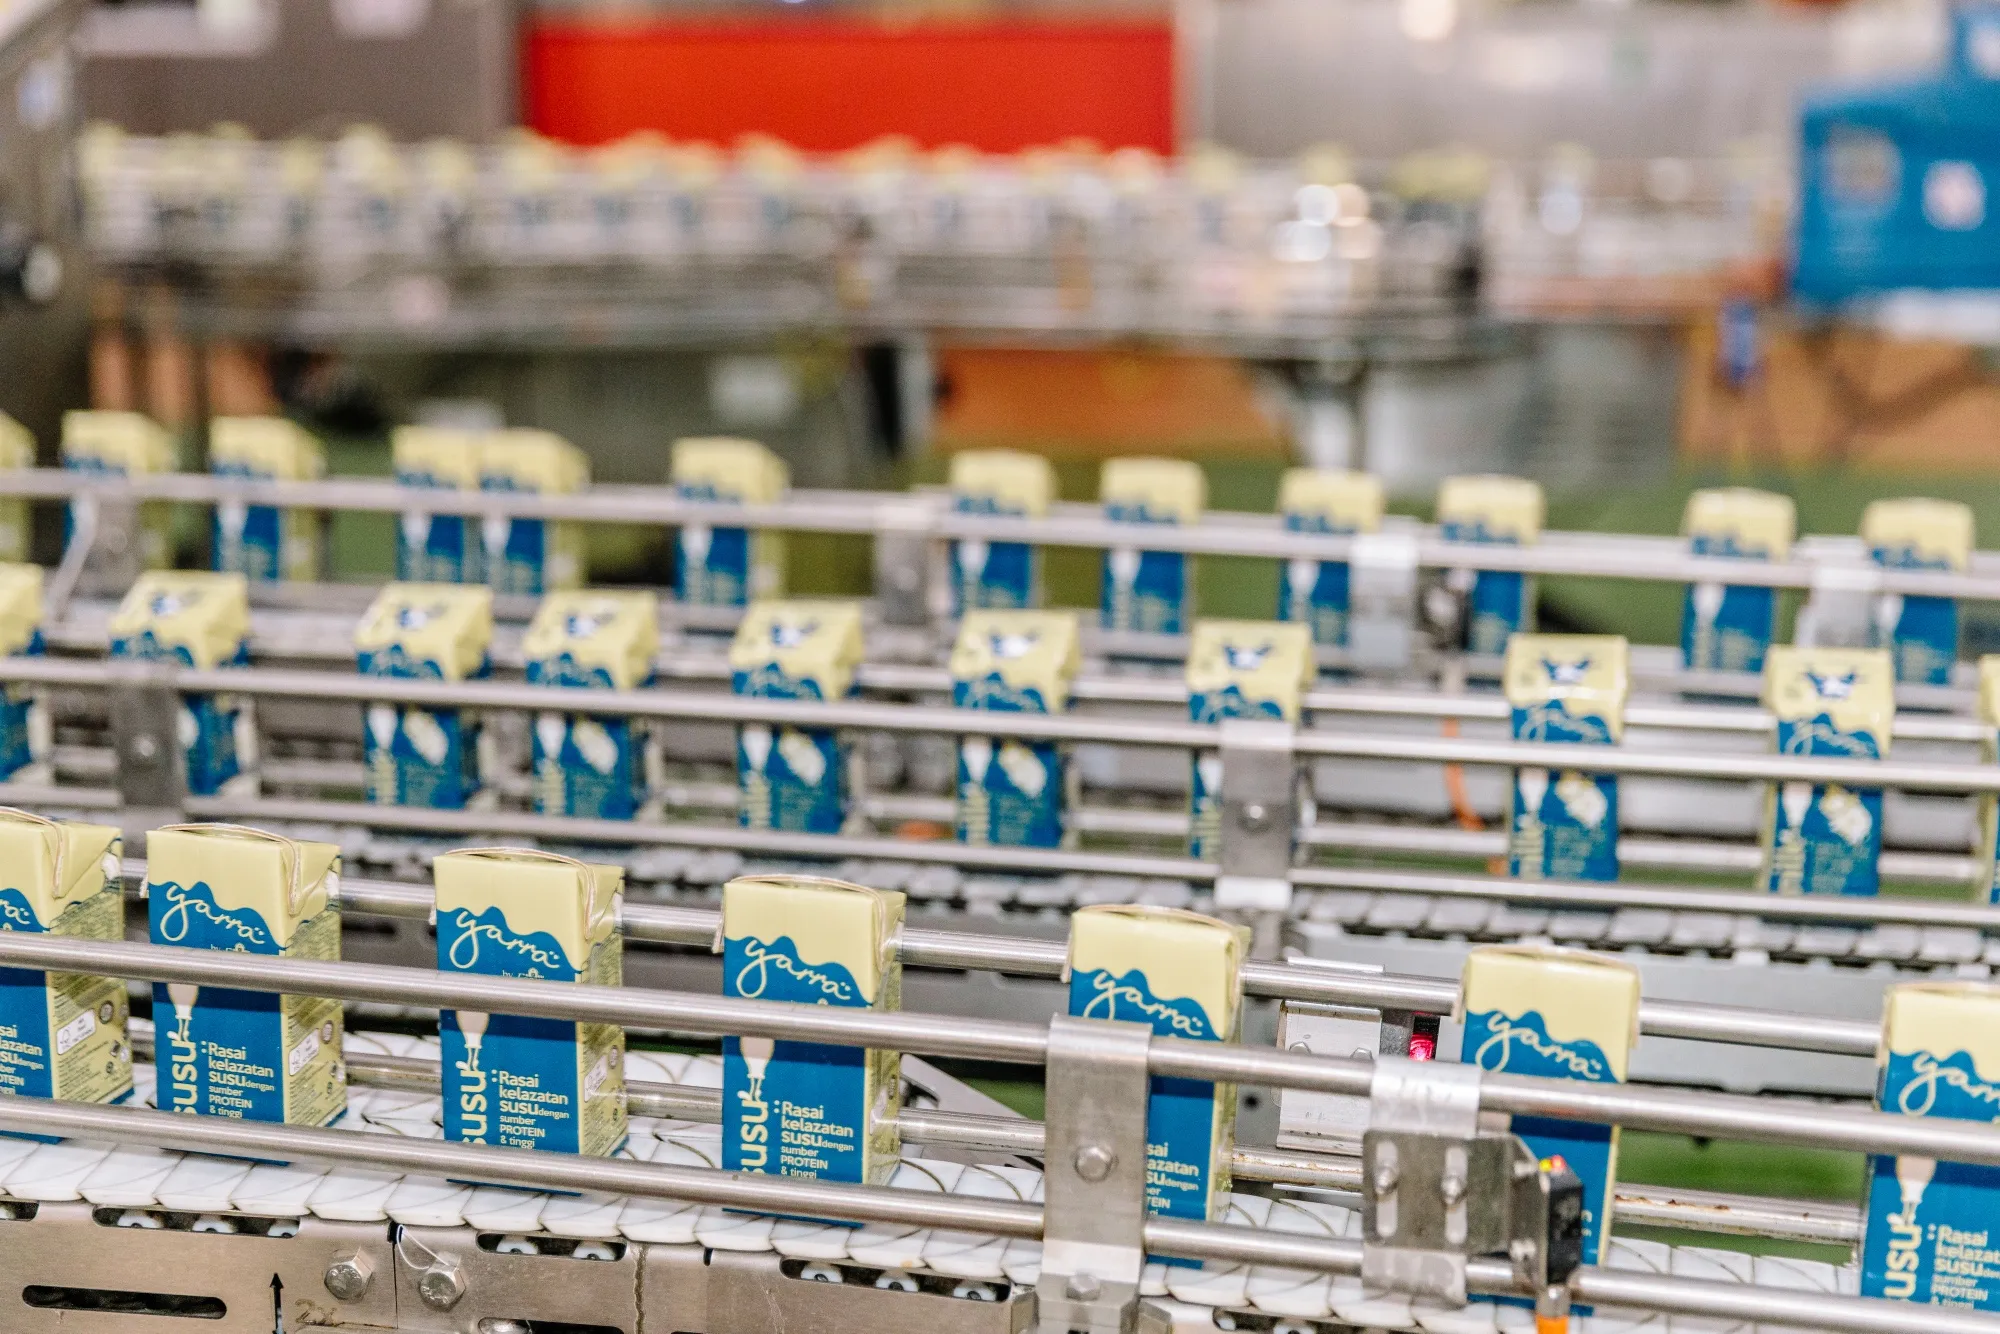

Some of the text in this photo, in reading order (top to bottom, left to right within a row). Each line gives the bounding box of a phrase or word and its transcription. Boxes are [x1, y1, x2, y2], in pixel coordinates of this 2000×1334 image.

[0, 1024, 17, 1039] sai
[0, 1036, 43, 1057] lazatan
[208, 1041, 247, 1060] Rasai
[208, 1056, 274, 1078] kelazatan
[499, 1070, 539, 1088] Rasai
[208, 1085, 244, 1096] sumber
[499, 1084, 569, 1106] kelazatan
[208, 1094, 253, 1109] PROTEIN
[209, 1105, 243, 1119] & tinggi
[781, 1100, 824, 1120] Rasai
[499, 1115, 537, 1126] sumber
[780, 1115, 854, 1138] kelazatan
[499, 1123, 546, 1138] PROTEIN
[500, 1134, 535, 1149] & tinggi
[780, 1145, 819, 1157] sumber
[1147, 1142, 1168, 1158] sai
[780, 1154, 829, 1170] PROTEIN
[1147, 1159, 1199, 1177] azatan
[780, 1166, 788, 1175] &
